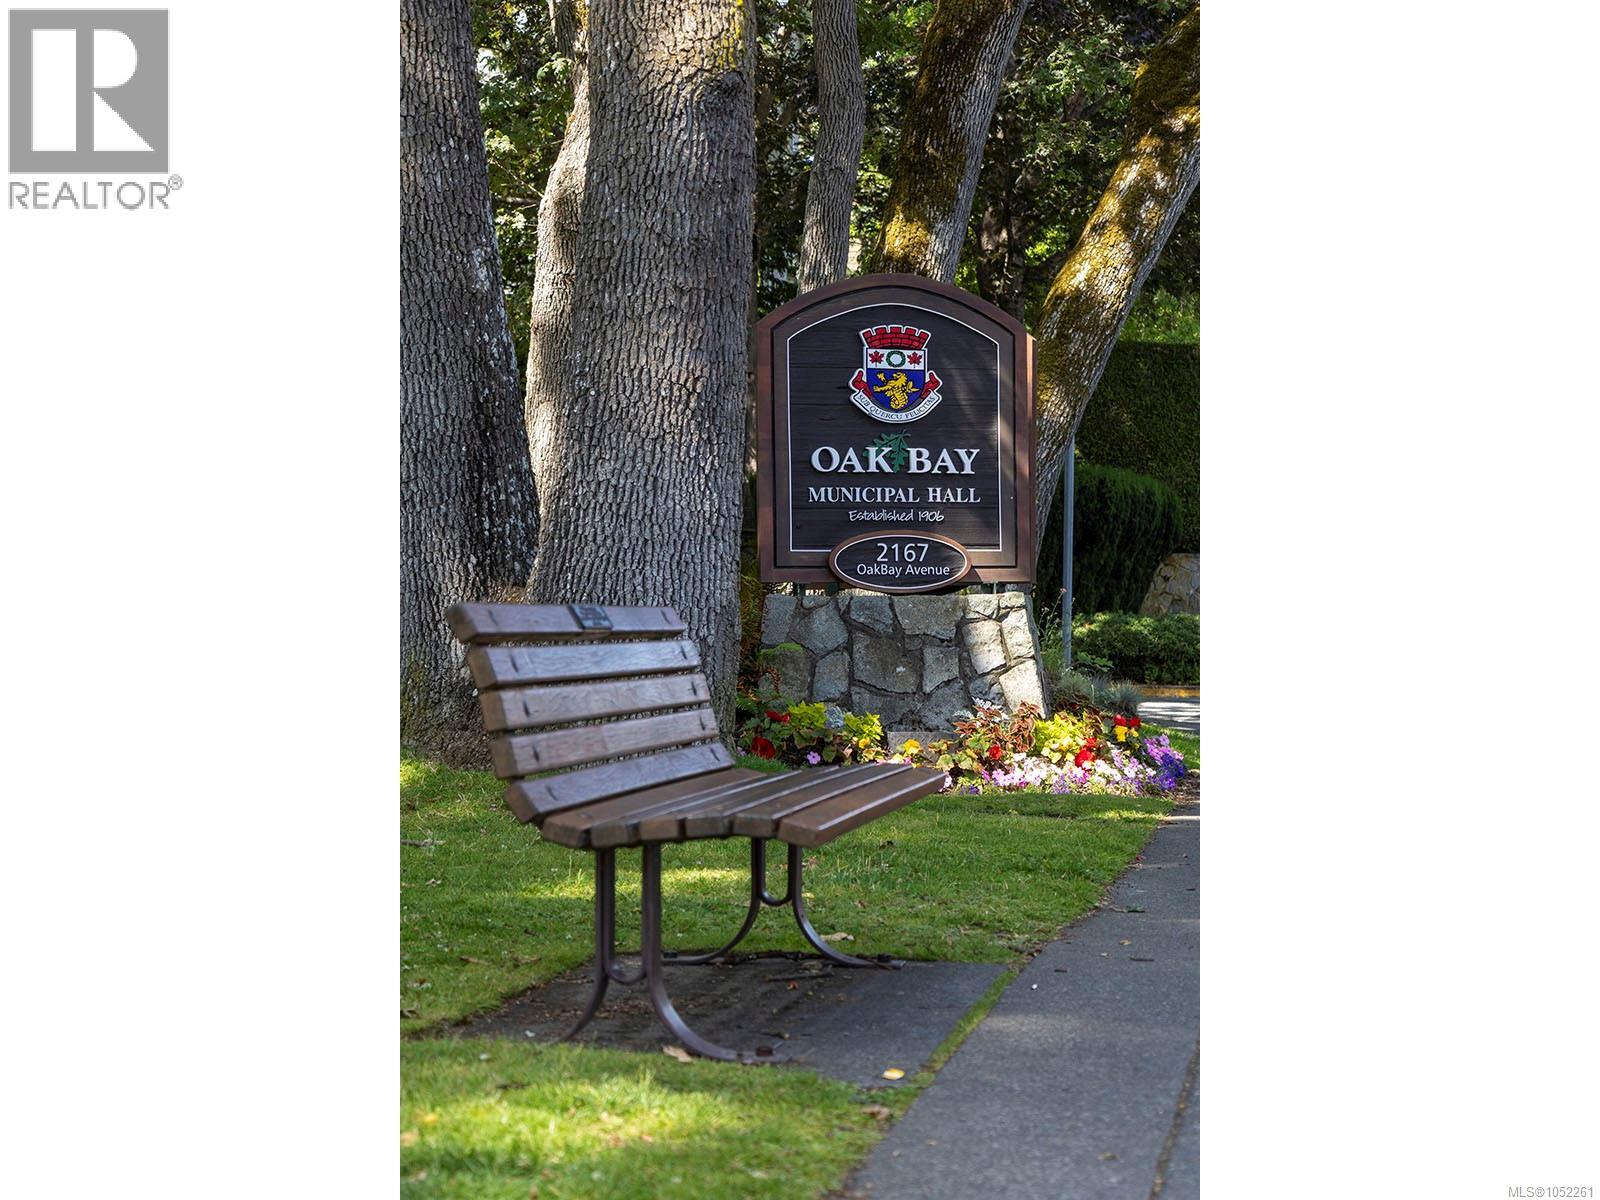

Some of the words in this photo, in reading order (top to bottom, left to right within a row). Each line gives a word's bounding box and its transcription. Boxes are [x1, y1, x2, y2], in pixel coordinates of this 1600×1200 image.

[857, 394, 869, 407] SUB
[869, 406, 902, 420] QUERCU
[905, 395, 936, 419] FELICITAS
[811, 446, 894, 474] OAK
[907, 447, 980, 475] BAY
[808, 486, 920, 504] MUNICIPAL
[927, 487, 981, 504] HALL
[848, 508, 914, 523] Established
[918, 510, 945, 523] 1906
[876, 543, 929, 563] 2167
[856, 563, 902, 578] OakBay
[904, 564, 950, 577] Avenue
